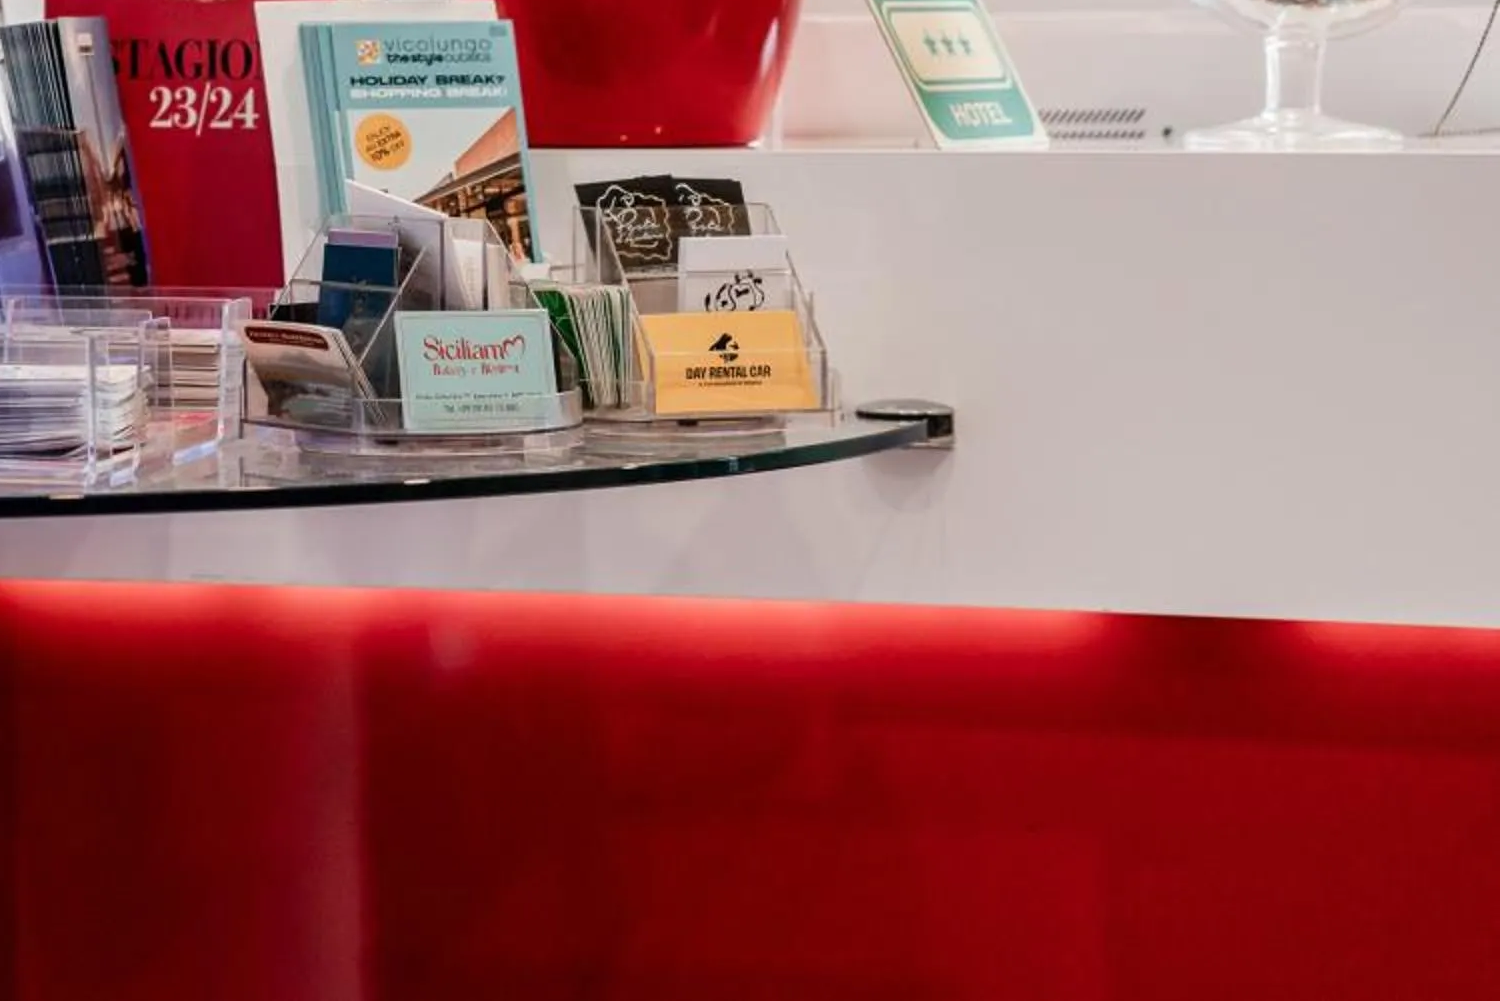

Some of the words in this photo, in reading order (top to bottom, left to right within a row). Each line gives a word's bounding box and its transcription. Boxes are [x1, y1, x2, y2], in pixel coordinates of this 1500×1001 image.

[111, 38, 263, 81] TAGIO
[350, 75, 429, 87] HOLIDAY
[436, 74, 505, 86] BREAK?
[149, 81, 260, 137] 23/24
[949, 101, 1013, 128] HOTEL
[685, 367, 707, 380] DAY
[709, 366, 748, 379] RENTAL
[749, 365, 771, 378] CAR
